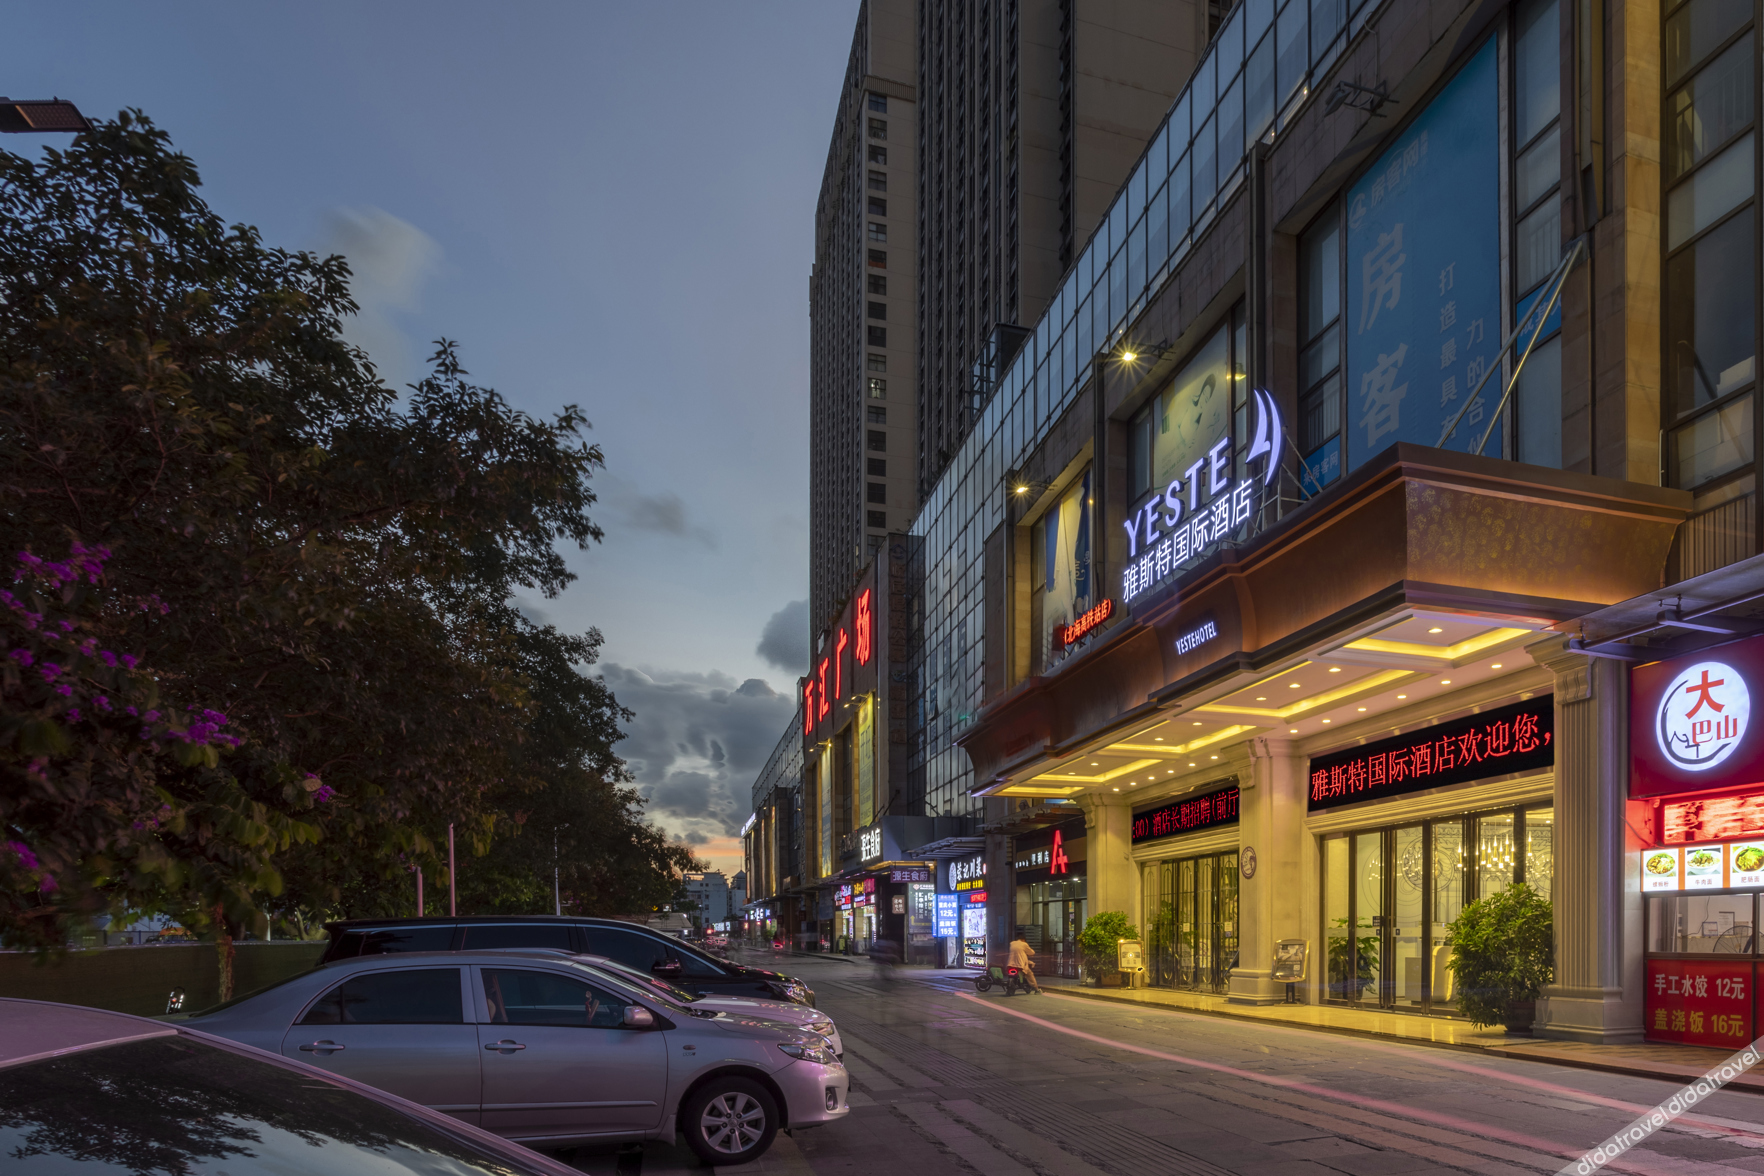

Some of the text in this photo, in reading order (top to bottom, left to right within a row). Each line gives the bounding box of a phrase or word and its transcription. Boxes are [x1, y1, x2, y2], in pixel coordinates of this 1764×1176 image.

[1371, 137, 1419, 209] 房客网
[1357, 222, 1410, 449] 房客
[1124, 436, 1231, 558] YESTE
[1123, 477, 1253, 604] 雅斯特国际酒店
[804, 588, 871, 736] 万汇广场
[1685, 669, 1726, 720] 大
[1692, 714, 1738, 745] 巴山
[1654, 973, 1745, 1000] 手工水饺 12元
[1654, 1008, 1744, 1037] 盖浇饭 16元
